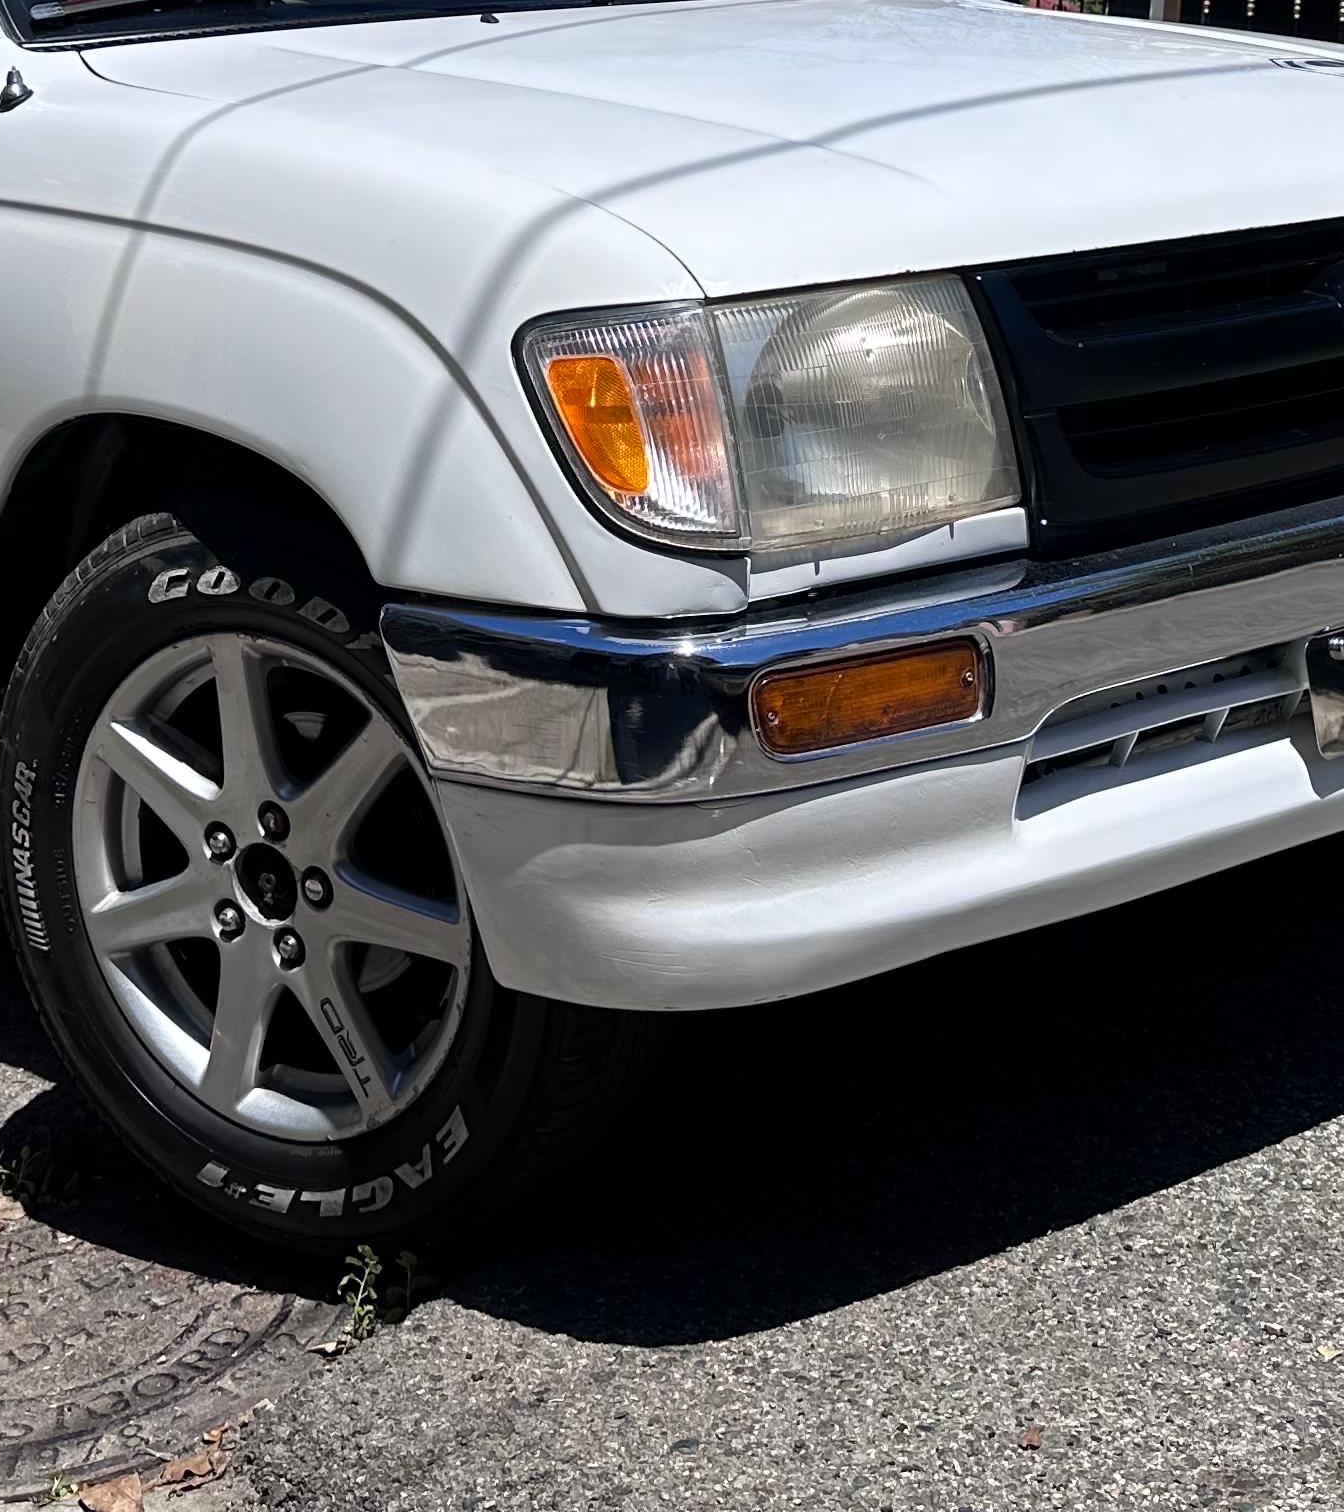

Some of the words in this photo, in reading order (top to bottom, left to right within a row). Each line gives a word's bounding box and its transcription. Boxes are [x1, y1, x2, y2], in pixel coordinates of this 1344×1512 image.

[11, 761, 38, 890] NASCAR
[319, 997, 371, 1099] TRD
[249, 1103, 470, 1217] EAGLE
